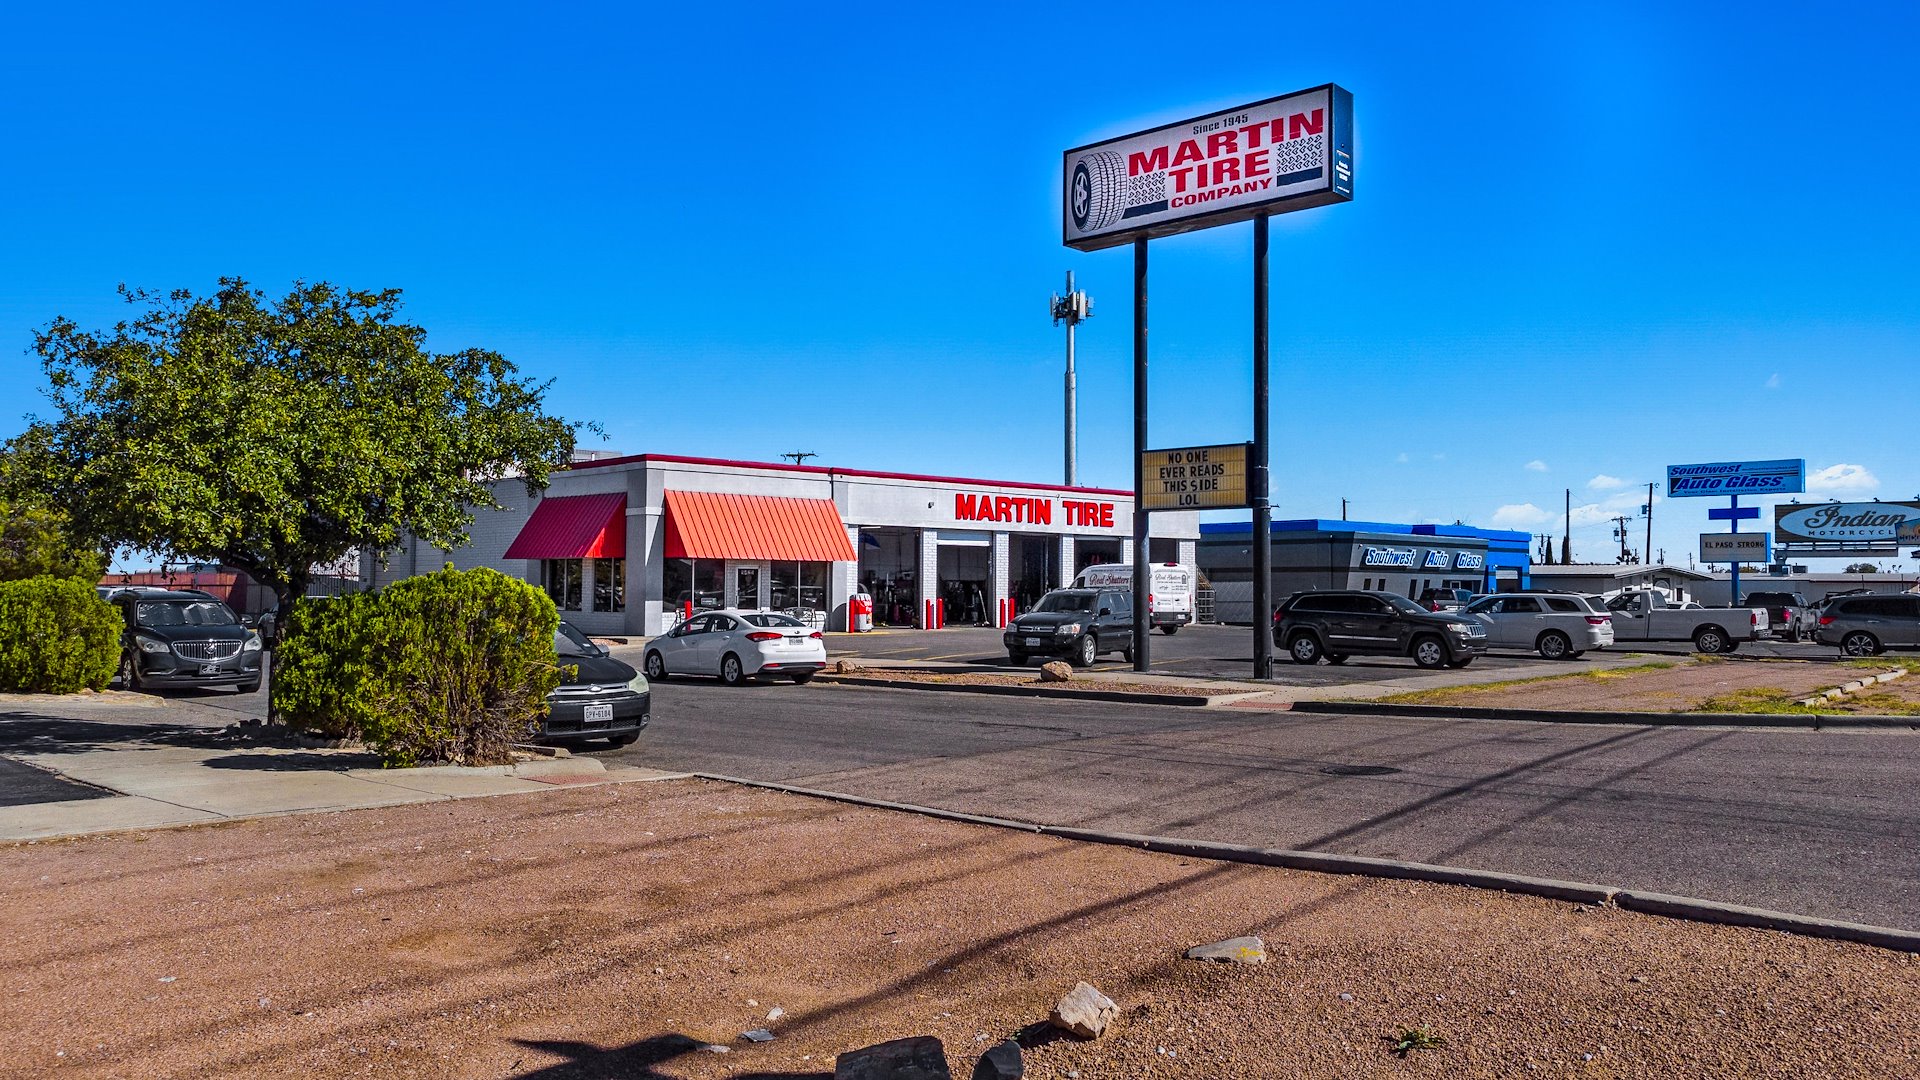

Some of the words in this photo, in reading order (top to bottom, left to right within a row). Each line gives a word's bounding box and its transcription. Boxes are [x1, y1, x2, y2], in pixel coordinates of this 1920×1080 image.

[1193, 121, 1220, 136] Since
[1223, 113, 1249, 129] 1945
[1128, 107, 1324, 177] MARTIN
[1168, 149, 1270, 194] TIRE
[1171, 177, 1272, 209] COMPANY
[1168, 452, 1182, 464] NO
[1186, 450, 1208, 462] ONE
[1160, 466, 1185, 479] EVER
[1190, 463, 1225, 477] READS
[1670, 464, 1742, 475] Southwest
[1163, 480, 1187, 492] THIS
[1190, 478, 1218, 492] SIDE
[1676, 477, 1722, 490] Auto
[1725, 475, 1784, 488] Glass
[1179, 494, 1199, 506] LOL
[955, 493, 1052, 525] MARTIN
[1062, 500, 1115, 528] TIRE
[1803, 505, 1907, 529] Indian
[1705, 541, 1714, 549] EL
[1366, 548, 1416, 566] Southwest
[1425, 550, 1449, 567] Auto
[1457, 551, 1482, 568] Glass
